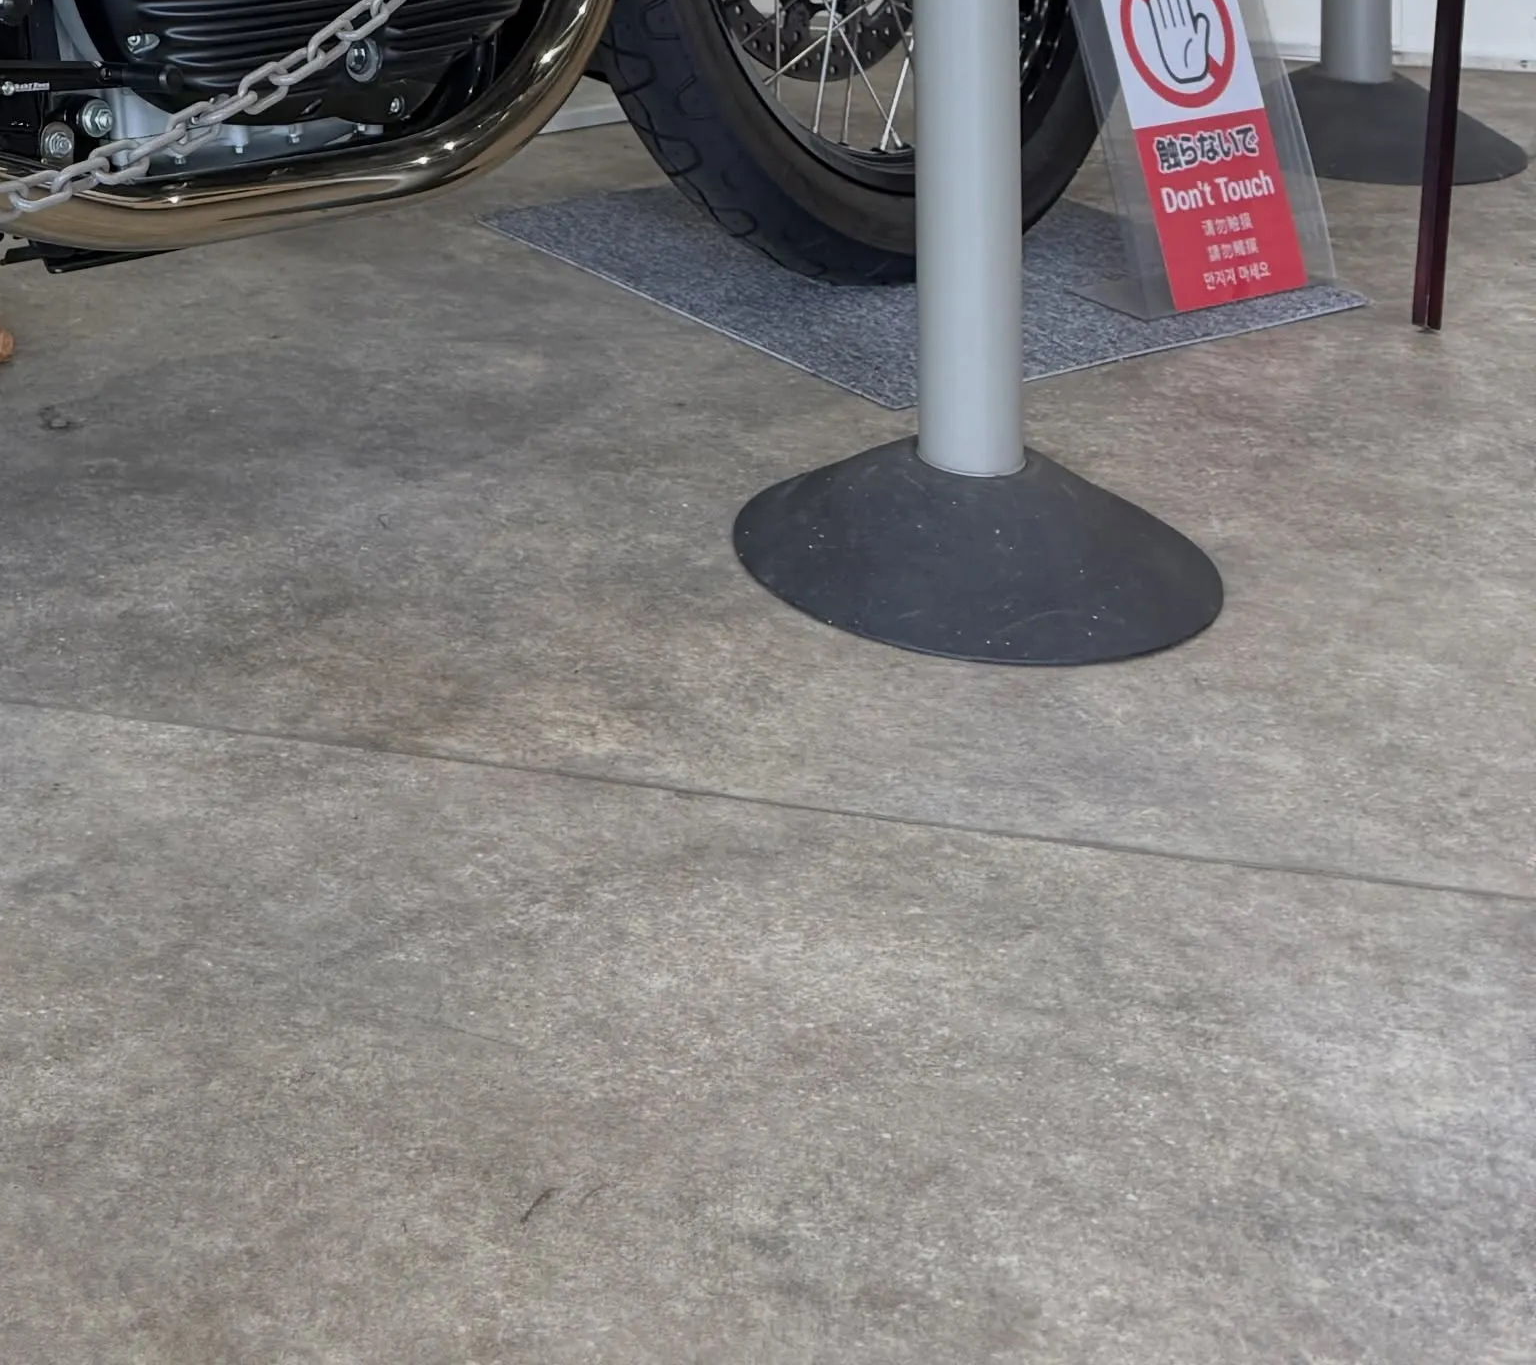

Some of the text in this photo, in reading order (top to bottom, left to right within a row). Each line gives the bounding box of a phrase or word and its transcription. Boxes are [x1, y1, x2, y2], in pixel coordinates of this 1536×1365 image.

[1153, 124, 1260, 173] 触らないで
[1161, 170, 1274, 213] Don't Touch
